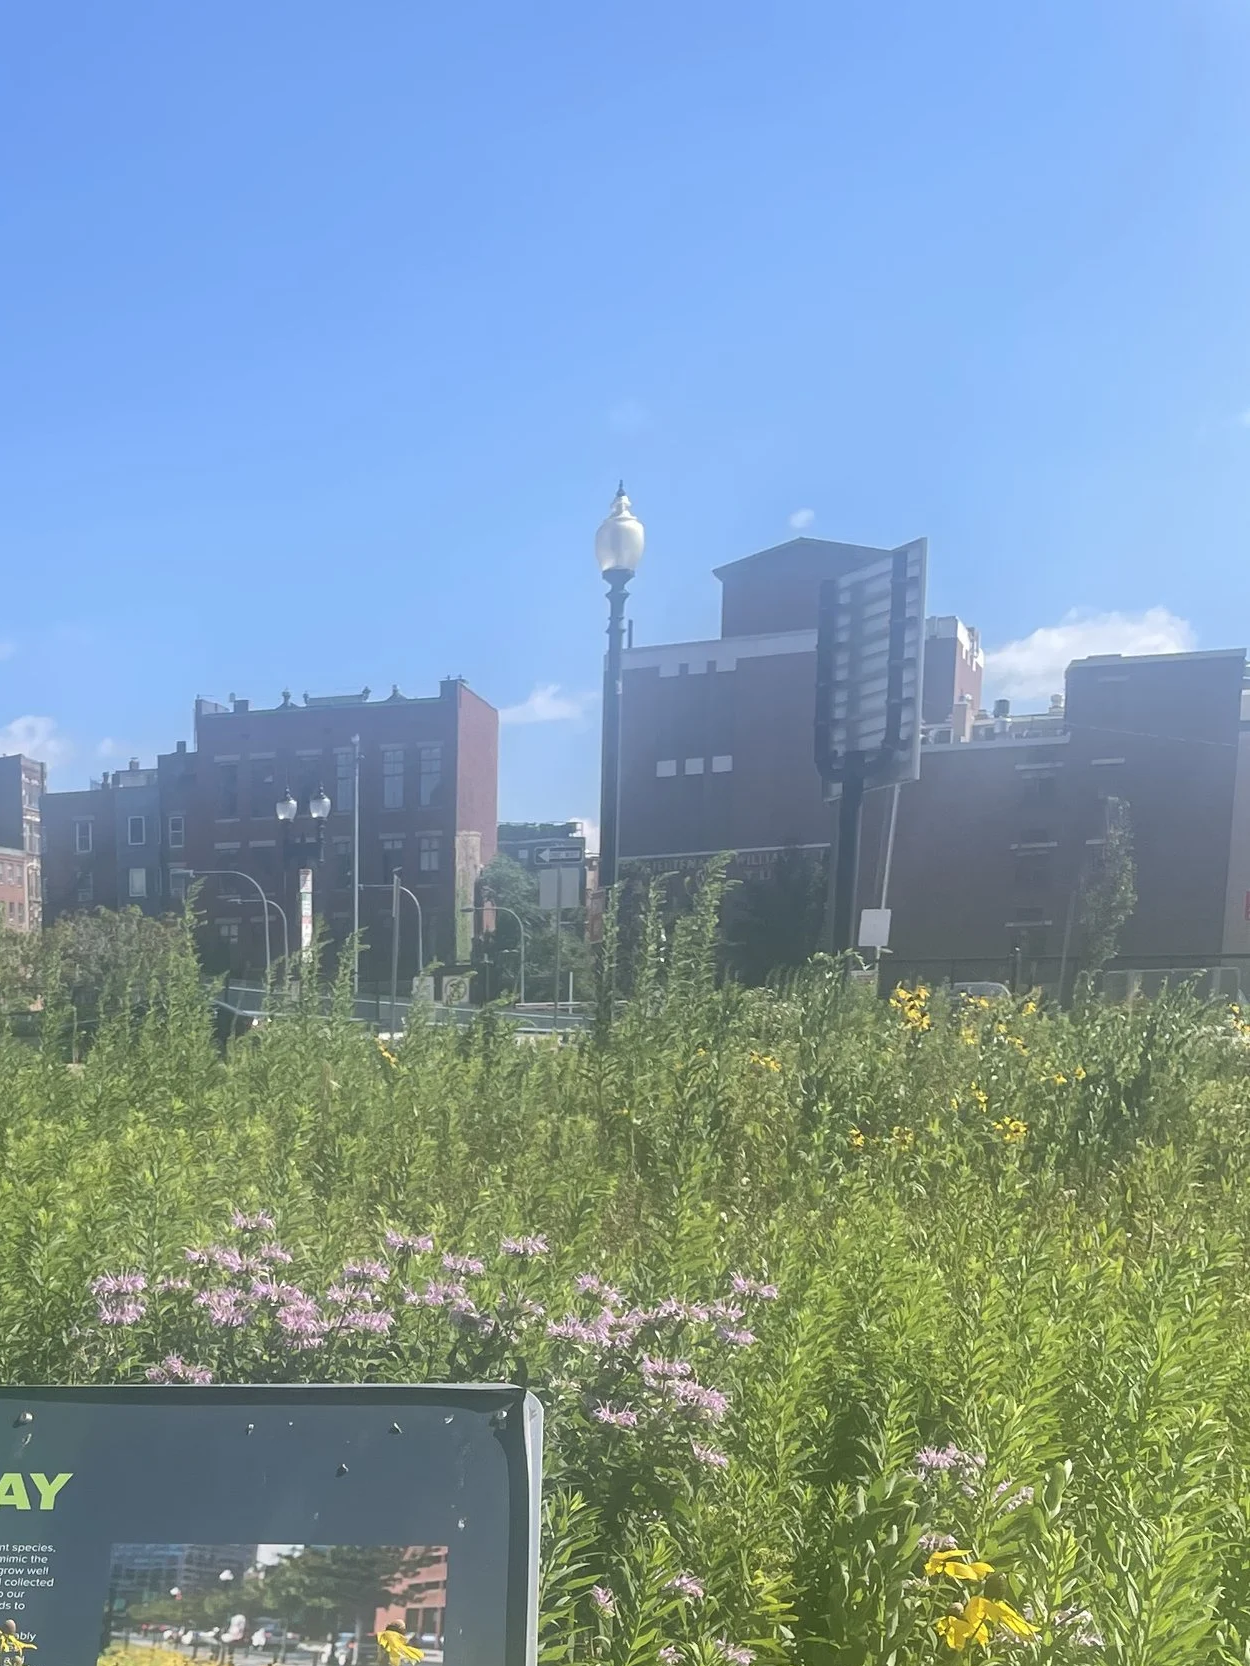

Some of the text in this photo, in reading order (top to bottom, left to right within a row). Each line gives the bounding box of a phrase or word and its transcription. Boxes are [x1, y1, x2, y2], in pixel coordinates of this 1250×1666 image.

[31, 1555, 48, 1563] the
[27, 1567, 49, 1575] well
[4, 1578, 54, 1587] collected
[14, 1602, 25, 1610] to
